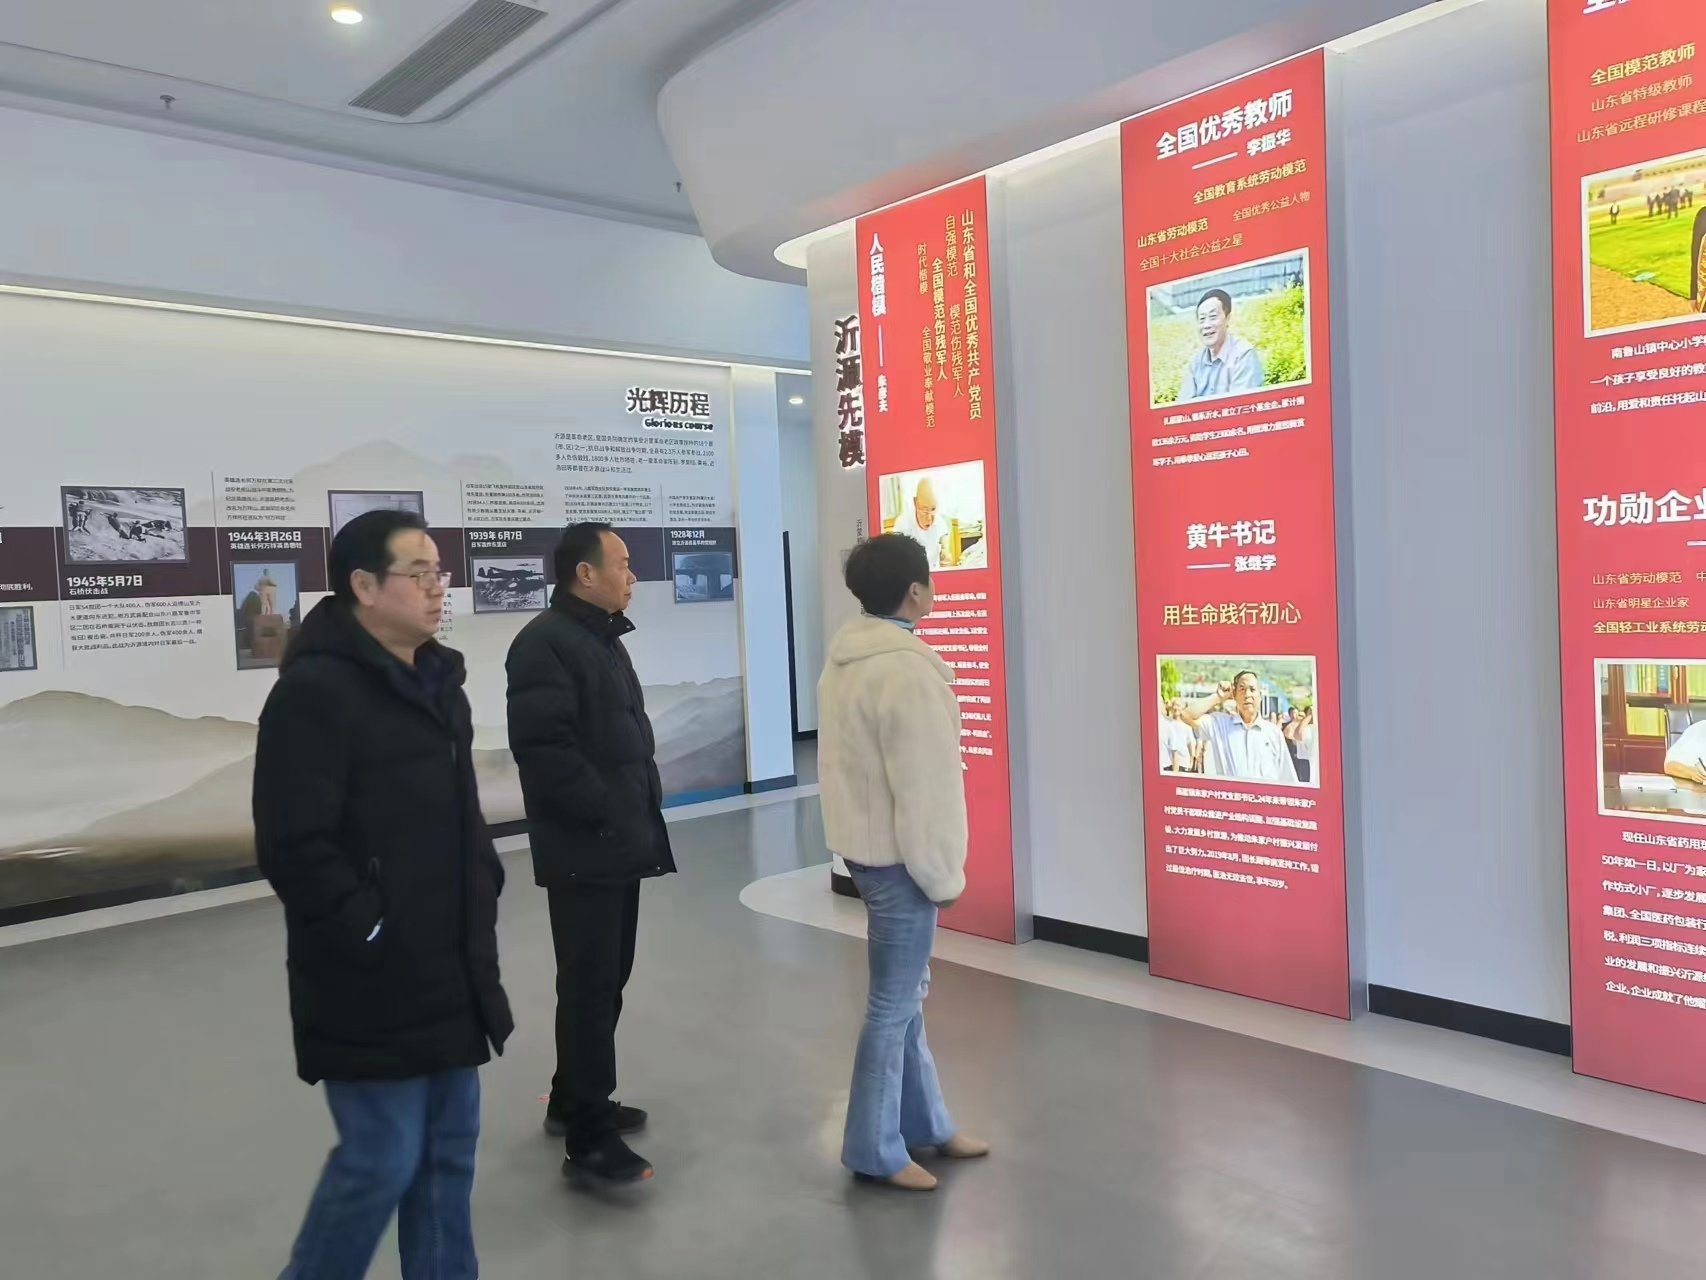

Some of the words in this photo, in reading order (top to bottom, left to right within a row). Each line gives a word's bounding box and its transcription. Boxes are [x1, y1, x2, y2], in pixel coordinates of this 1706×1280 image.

[1590, 42, 1696, 86] 全国模范教师
[1591, 74, 1693, 112] 山东省特级教师
[1155, 88, 1293, 161] 全国优秀教师
[1246, 128, 1292, 157] 李振华
[1192, 158, 1307, 205] 全国教育系统劳动模范
[1137, 217, 1209, 248] 山东省劳动模范
[1232, 190, 1311, 222] 全国优秀公益人物
[945, 214, 959, 277] 自强模范
[1139, 232, 1243, 272] 全国十大社会公益之星
[869, 232, 888, 318] 人民楷模
[917, 242, 929, 295] 时代楷模
[931, 256, 948, 382] 全国模范伤残军人
[961, 208, 982, 420] 山东省和全国优秀共产党员
[949, 304, 964, 399] 模范伤残军人
[921, 325, 936, 428] 全国敬业奉献模范
[1590, 362, 1706, 387] 一个孩子享受良好的教
[626, 386, 710, 417] 光辉历程
[645, 418, 683, 429] Glorious
[684, 422, 714, 431] course
[228, 531, 302, 542] 1944年3月26日
[469, 531, 497, 541] 1939年
[498, 531, 523, 541] 6月7日
[670, 529, 705, 539] 1928年12月
[1186, 519, 1277, 550] 黄牛书记
[1234, 554, 1277, 572] 张继学
[1593, 571, 1682, 585] 山东省劳动模范
[67, 575, 143, 587] 1945年5月7日
[69, 587, 109, 596] 石桥伏击战
[1162, 601, 1302, 626] 用生命践行初心
[1593, 596, 1690, 609] 山东省明星企业家
